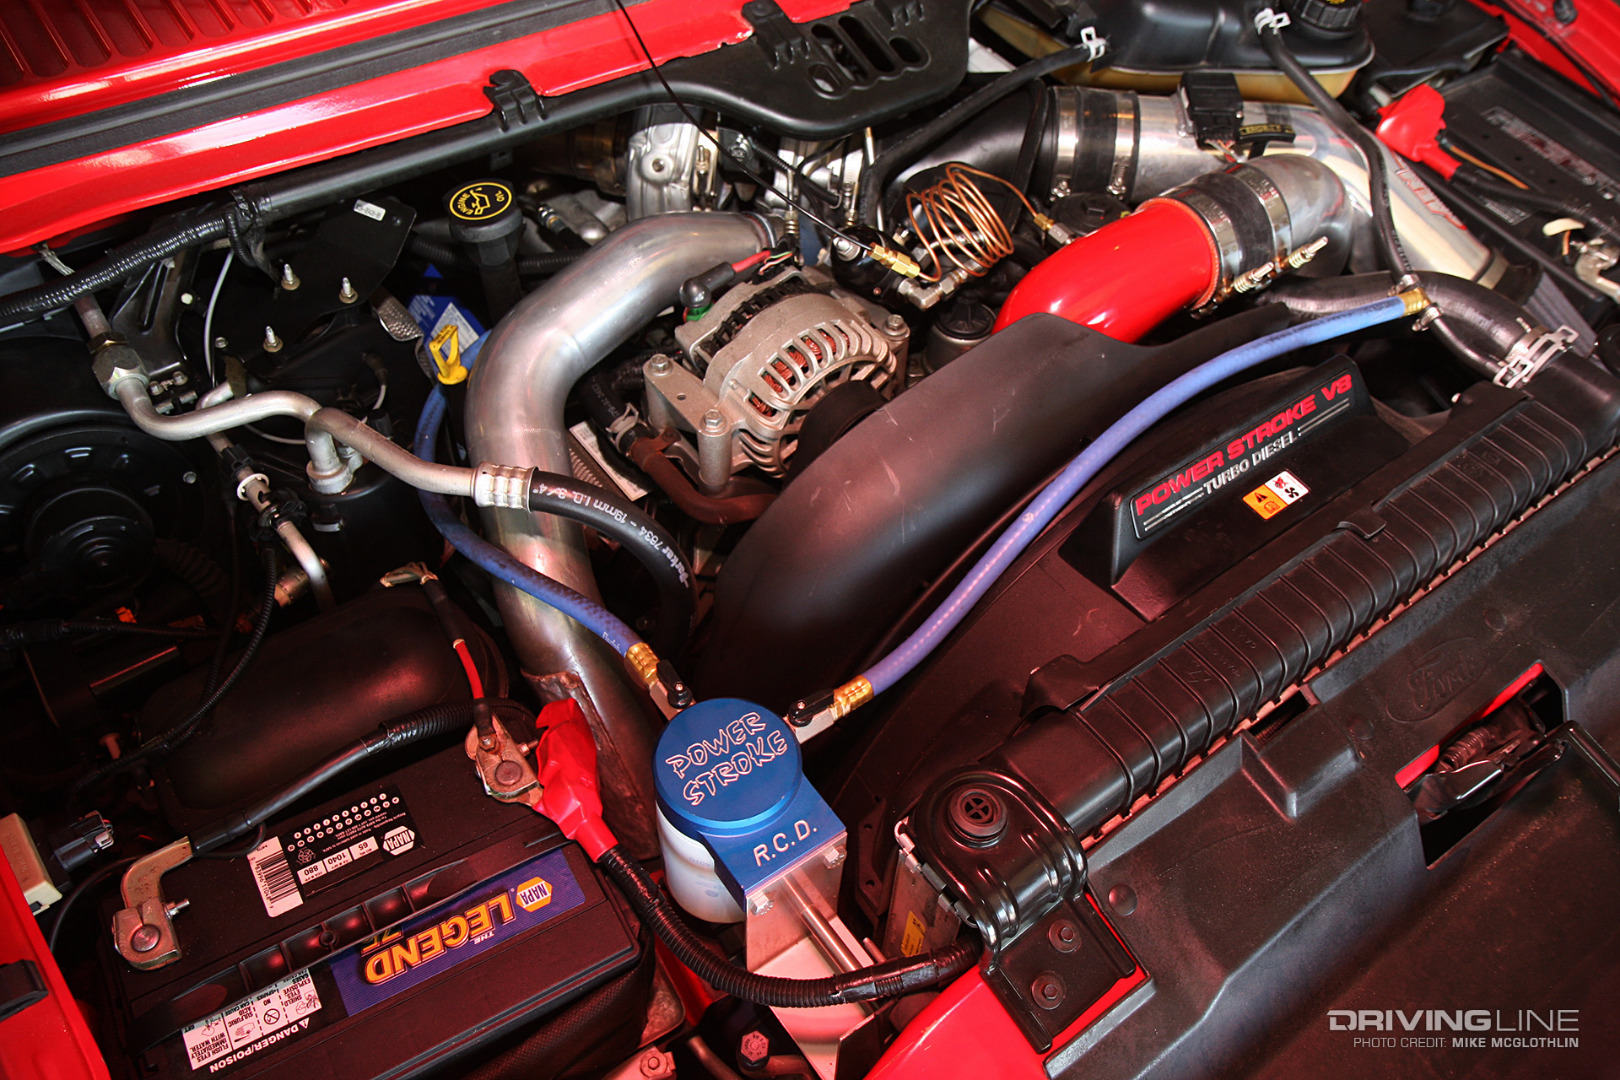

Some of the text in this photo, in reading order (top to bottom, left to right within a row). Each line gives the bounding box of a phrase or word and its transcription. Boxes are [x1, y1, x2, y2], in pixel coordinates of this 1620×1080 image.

[457, 193, 474, 215] ENGINE
[495, 190, 505, 202] OIL
[1135, 374, 1353, 516] POWER STROKE V8
[1203, 430, 1298, 495] TURBO DIESEL
[593, 502, 628, 524] 19mm
[665, 712, 767, 779] POWER
[683, 730, 788, 806] STROKE
[358, 841, 369, 850] 65
[386, 831, 411, 850] NAPA
[753, 819, 818, 867] R.C.D.
[327, 852, 347, 865] 1040
[303, 865, 319, 876] 880
[519, 882, 549, 906] NAPA
[364, 889, 517, 987] LEGEND
[470, 931, 495, 945] THE
[282, 978, 311, 994] EXPLOSIVE
[292, 972, 310, 984] GASES
[263, 998, 272, 1006] NO
[284, 996, 302, 1007] SHIELD
[228, 1012, 254, 1028] SULFURIC
[239, 1007, 251, 1016] ACID
[211, 1032, 226, 1043] WITH
[191, 1038, 228, 1060] IMMEDIATELY
[197, 1043, 229, 1063] FLUSH EYES
[209, 1023, 300, 1073] DANGER/POISON
